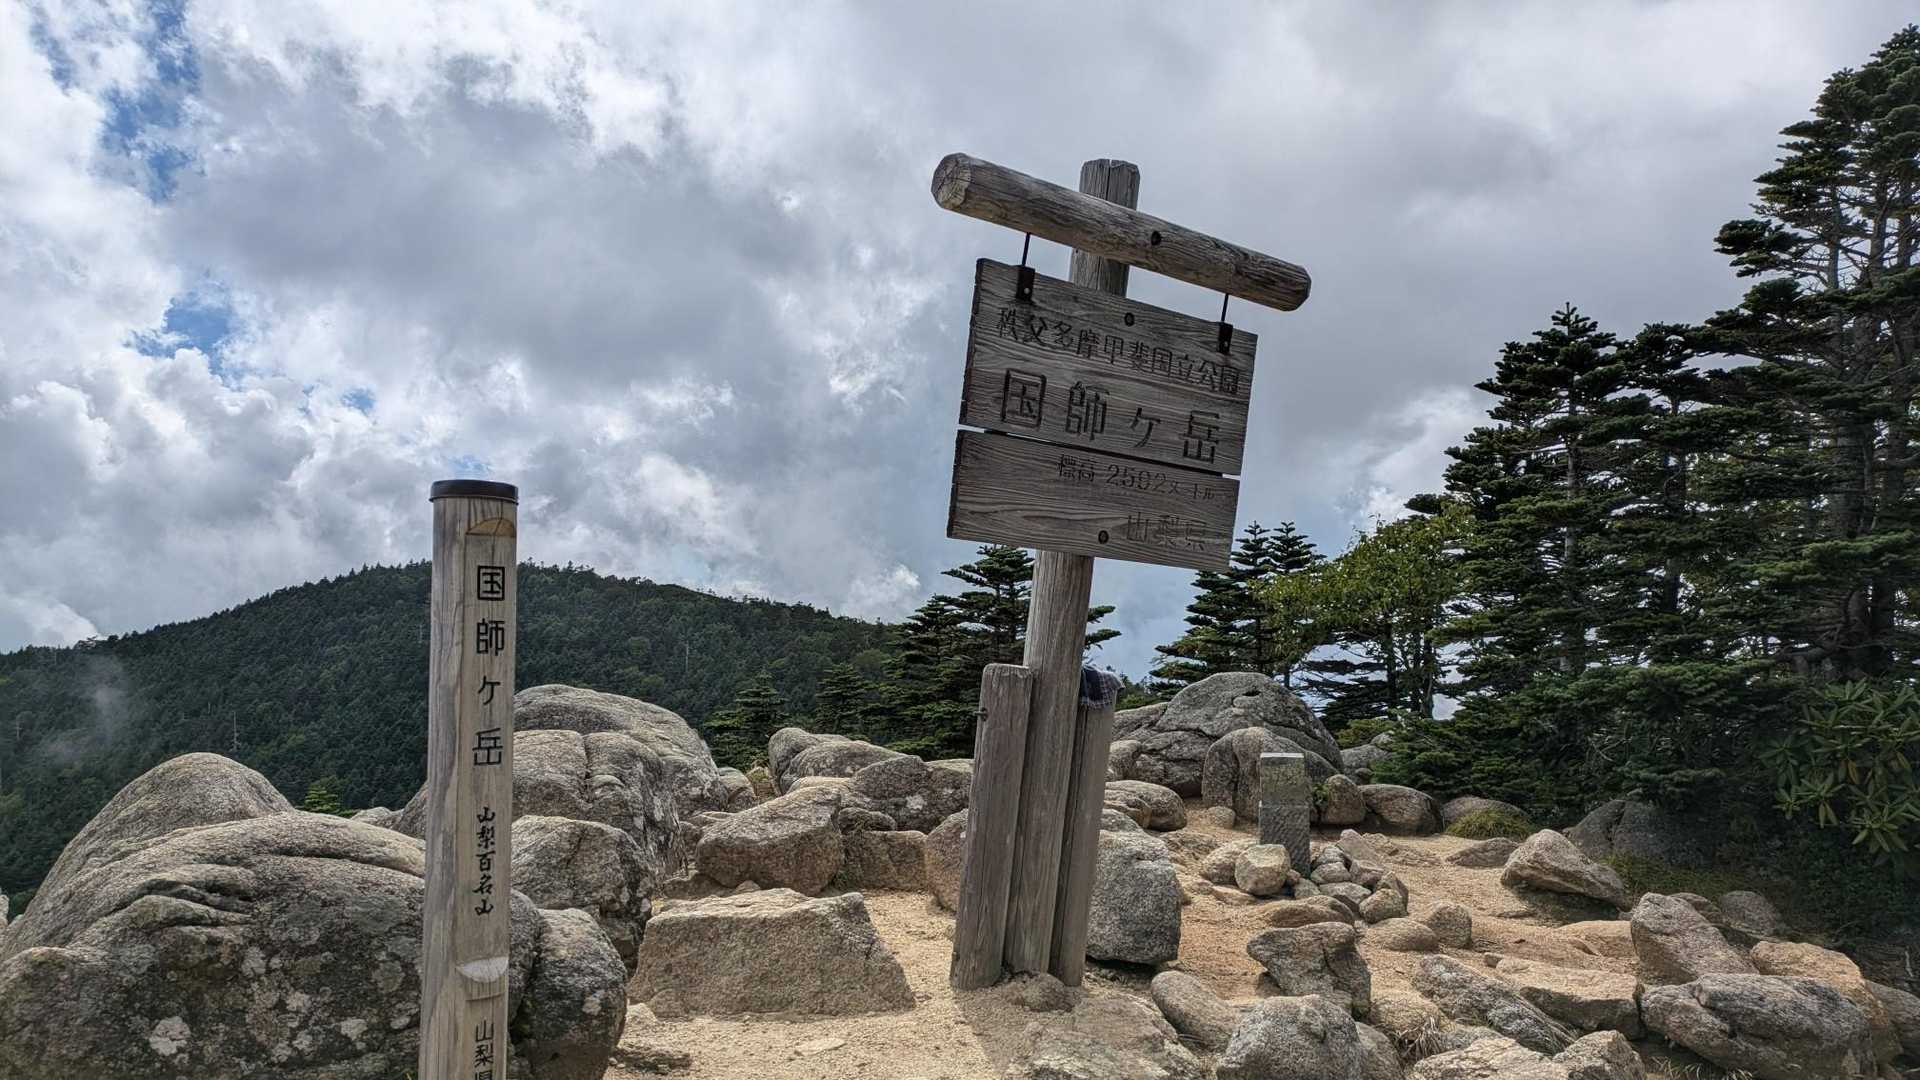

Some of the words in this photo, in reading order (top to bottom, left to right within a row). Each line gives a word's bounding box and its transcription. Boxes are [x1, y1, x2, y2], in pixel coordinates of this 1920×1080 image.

[1057, 454, 1097, 483] 標高
[472, 806, 496, 917] 山梨百名山
